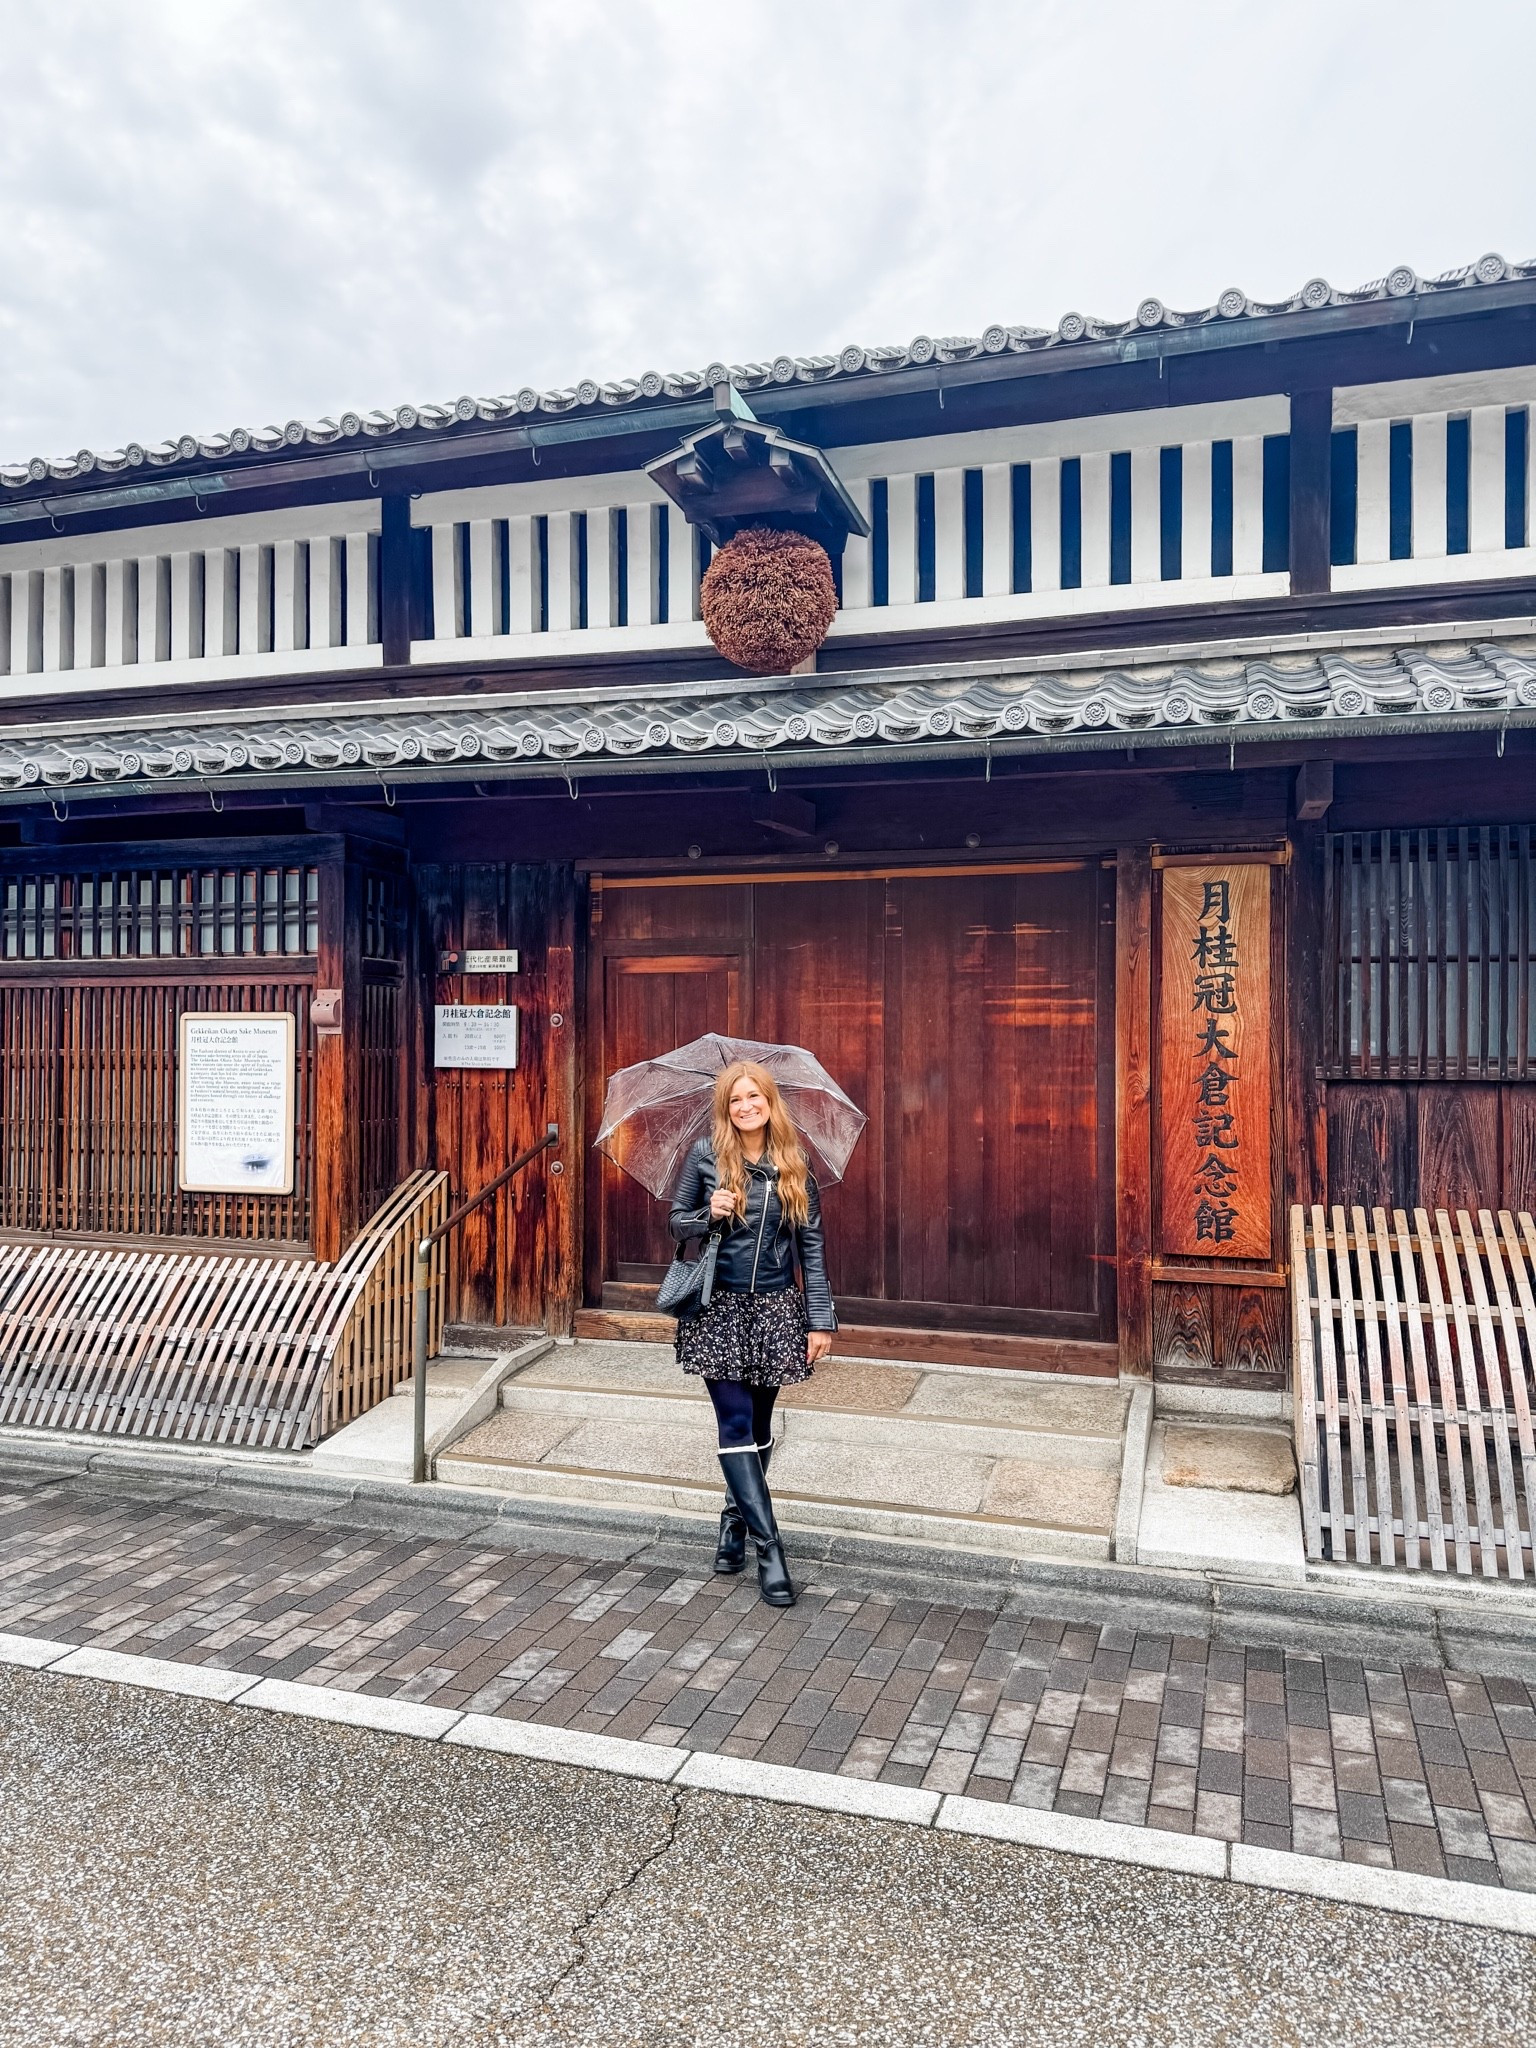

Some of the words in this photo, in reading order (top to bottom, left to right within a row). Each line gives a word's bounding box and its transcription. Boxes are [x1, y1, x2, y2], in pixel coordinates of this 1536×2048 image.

[442, 1008, 511, 1018] 月桂冠大倉記念館
[1190, 880, 1240, 1243] 月桂冠大倉記念館
